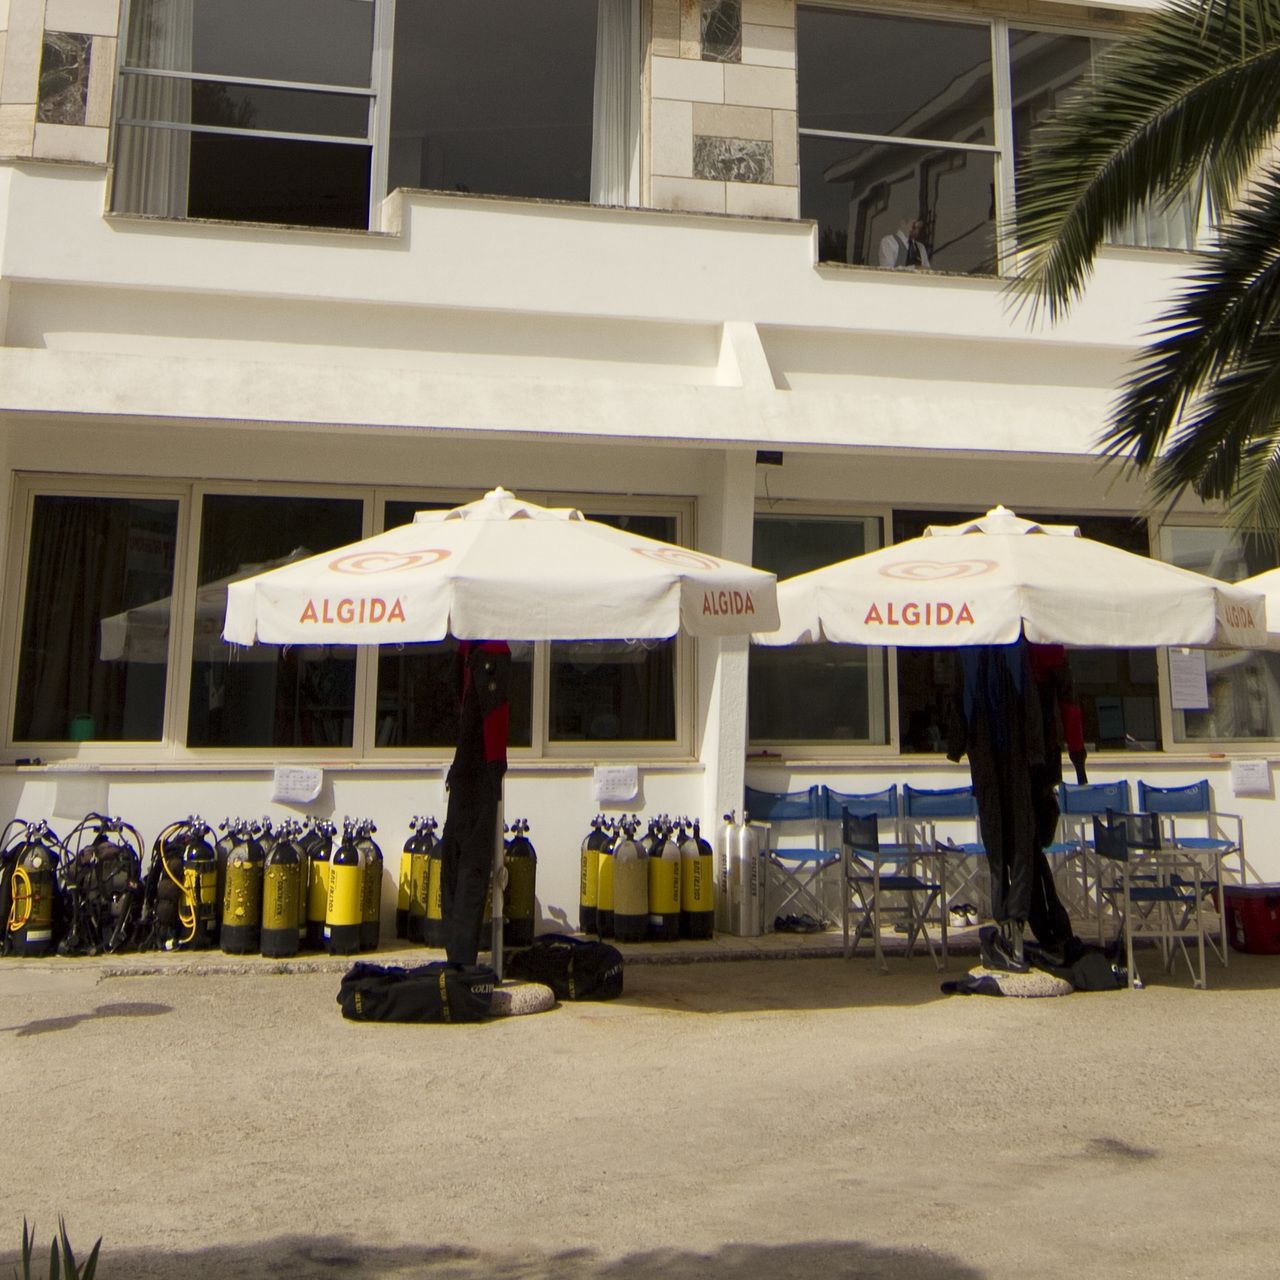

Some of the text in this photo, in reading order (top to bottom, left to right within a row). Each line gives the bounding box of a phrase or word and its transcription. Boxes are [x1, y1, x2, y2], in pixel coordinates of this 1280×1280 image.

[299, 597, 406, 625] ALGIDA
[703, 590, 755, 616] ALGIDA
[863, 602, 975, 626] ALGIDA
